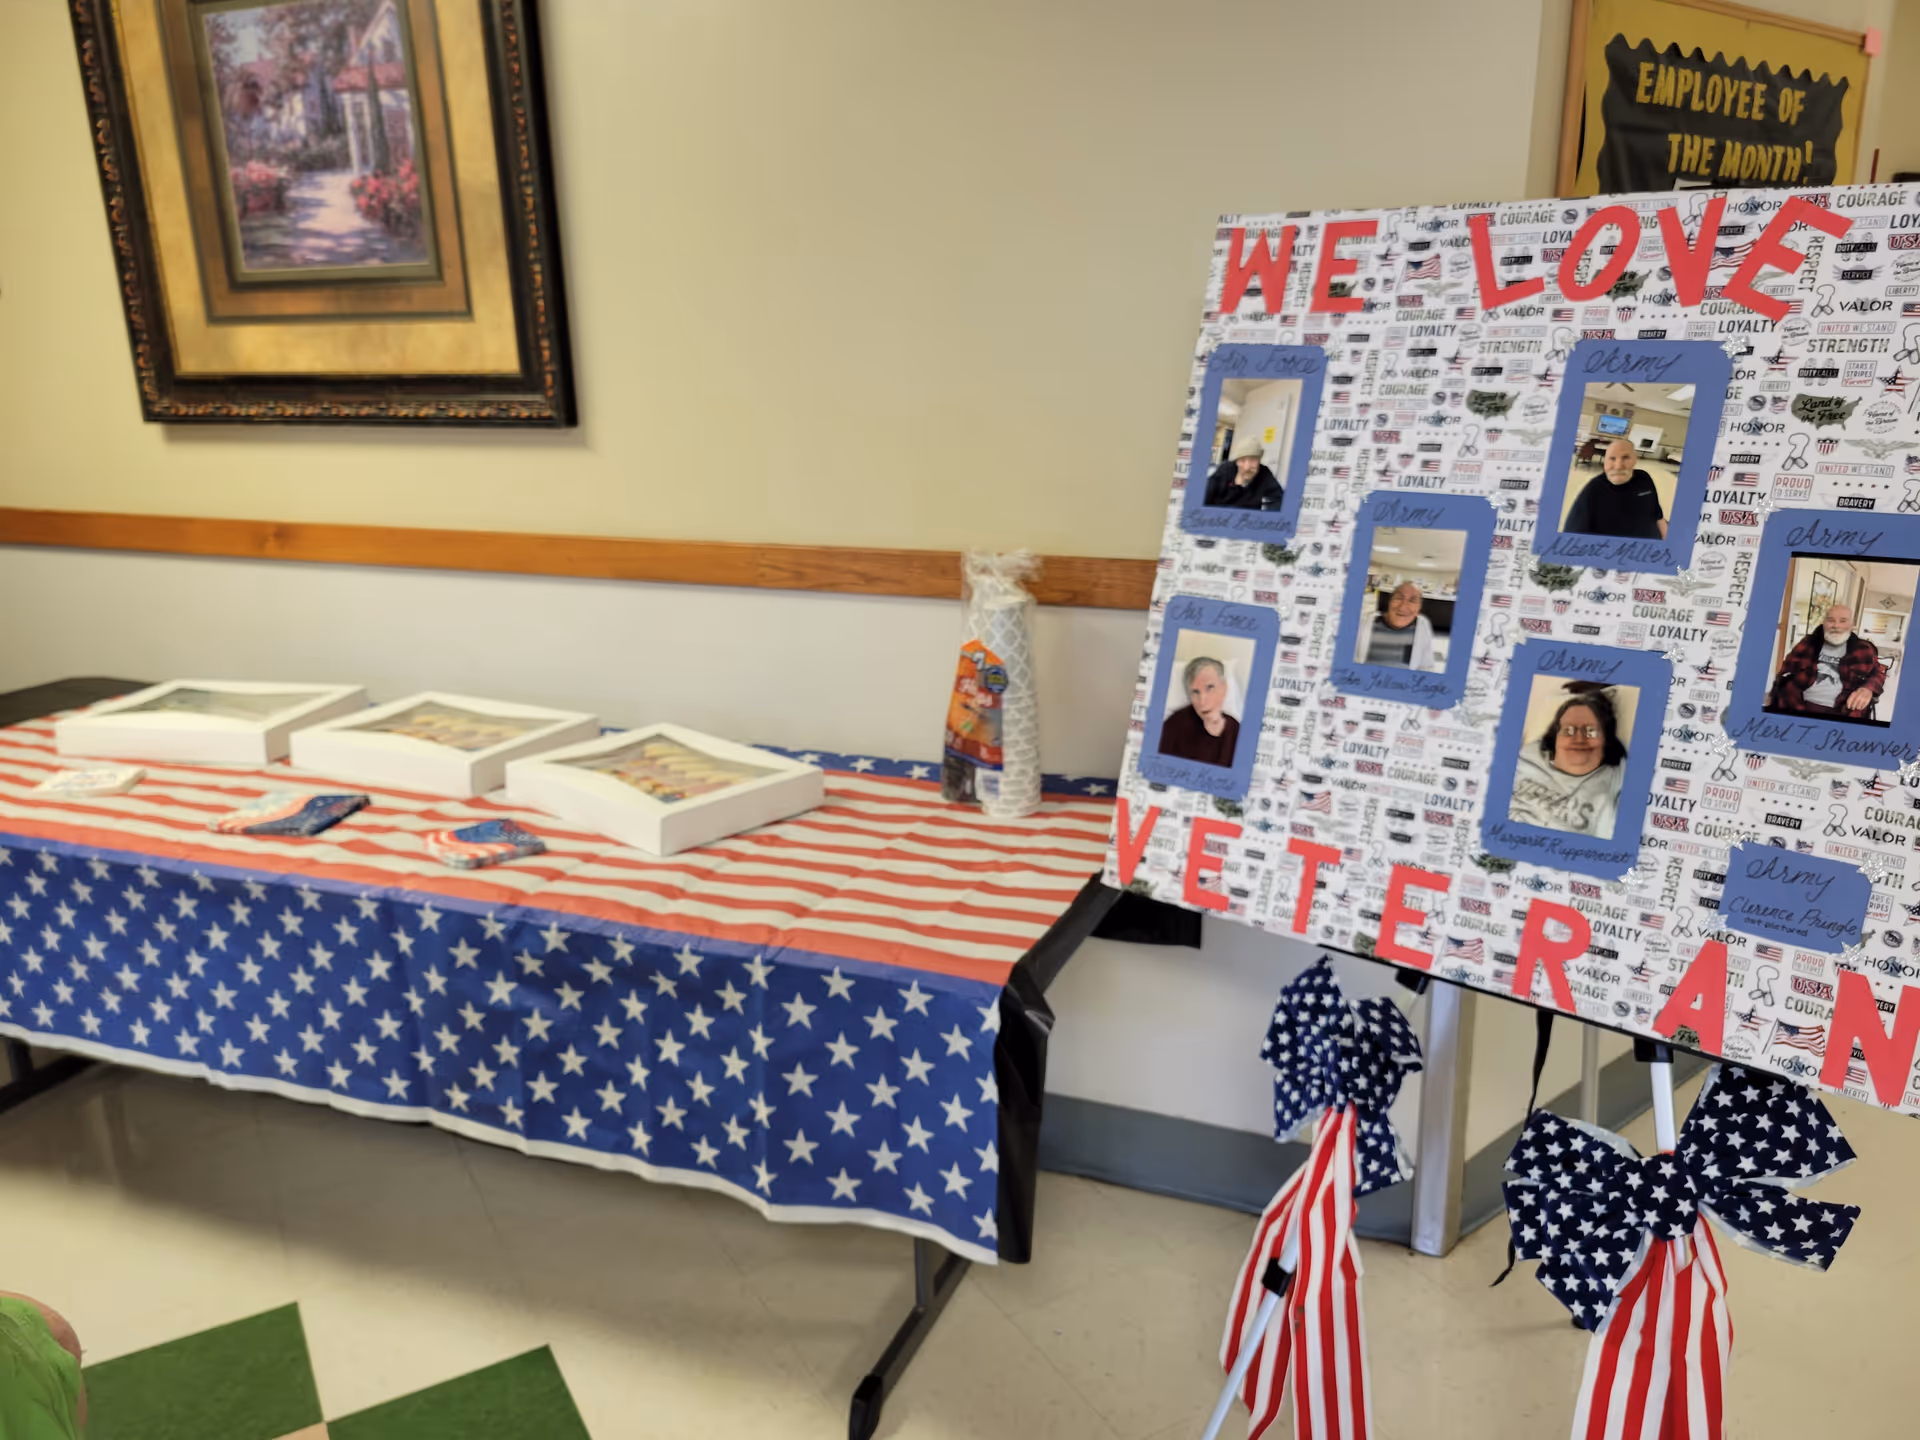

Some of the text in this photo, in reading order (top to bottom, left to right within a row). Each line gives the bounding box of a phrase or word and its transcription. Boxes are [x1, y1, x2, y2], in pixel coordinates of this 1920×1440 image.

[1636, 62, 1806, 126] EMPLOYEE OF
[1667, 134, 1813, 185] THE MONTH!
[1727, 200, 1783, 214] HONOR
[1837, 190, 1908, 209] COURAGE
[1416, 219, 1459, 232] HONOR
[1500, 210, 1556, 226] COURAGE
[1468, 195, 1855, 324] LOVE
[1798, 236, 1825, 293] RESPECT
[1218, 222, 1379, 315] WE
[1843, 271, 1872, 279] SERVICE
[1888, 286, 1917, 295] LIBERTY
[1503, 307, 1545, 318] VALOR
[1839, 300, 1893, 312] VALOR
[1396, 308, 1447, 323] COURAGE
[1409, 325, 1457, 338] LOYALTY
[1718, 319, 1779, 334] LOYALTY
[1820, 323, 1850, 333] UNITED
[1853, 323, 1866, 333] WE
[1478, 340, 1543, 354] STRENGTH
[1806, 337, 1891, 354] STRENGTH
[1255, 348, 1323, 376] Force
[1582, 347, 1683, 382] Army
[1401, 369, 1440, 378] VALOR
[1799, 370, 1816, 378] DUTY
[1846, 370, 1873, 378] STRIPES
[1379, 384, 1429, 396] COURAGE
[1762, 382, 1788, 391] LIBERTY
[1799, 397, 1834, 413] Land
[1817, 410, 1846, 422] Free
[1324, 419, 1369, 431] LOYALTY
[1730, 421, 1786, 434] HONOR
[1819, 464, 1891, 477] UNITED WE STAND
[1397, 475, 1447, 489] LOYALTY
[1775, 476, 1811, 489] PROUD
[1704, 490, 1767, 506] LOYALTY
[1838, 498, 1874, 509] BRAVERY
[1373, 498, 1446, 528] Army
[1720, 509, 1759, 527] USA
[1784, 519, 1884, 555] Army
[1541, 536, 1611, 558] Albert
[1604, 540, 1678, 567] Miller
[1725, 551, 1753, 607] RESPECT
[1577, 589, 1626, 604] HONOR
[1633, 589, 1666, 604] USA
[1632, 604, 1696, 624] COURAGE
[1649, 624, 1709, 643] LOYALTY
[1537, 648, 1623, 682] Army
[1272, 677, 1317, 694] LOYALTY
[1732, 716, 1795, 743] Merl
[1342, 741, 1390, 759] LOYALTY
[1331, 777, 1368, 792] VALOR
[1387, 766, 1440, 786] COURAGE
[1705, 786, 1740, 802] PROUD
[1746, 778, 1818, 799] UNITED WE STAND
[1424, 792, 1476, 814] LOYALTY
[1652, 813, 1690, 834] USA
[1765, 814, 1801, 829] BRAVERY
[1851, 825, 1906, 846] VALOR
[1828, 844, 1859, 859] UNITED
[1514, 874, 1563, 894] HONOR
[1658, 855, 1684, 912] RESPECT
[1744, 856, 1836, 903] Army
[1570, 881, 1602, 899] USA
[1453, 914, 1508, 937] COURAGE
[1764, 920, 1810, 938] pictured
[1798, 908, 1859, 940] Pringle
[1698, 926, 1748, 948] VALOR
[1116, 797, 1920, 1107] VETERAN
[1795, 954, 1825, 968] PROUD
[1441, 966, 1486, 985] HONOR
[1575, 965, 1621, 985] VALOR
[1791, 977, 1834, 1001] USA
